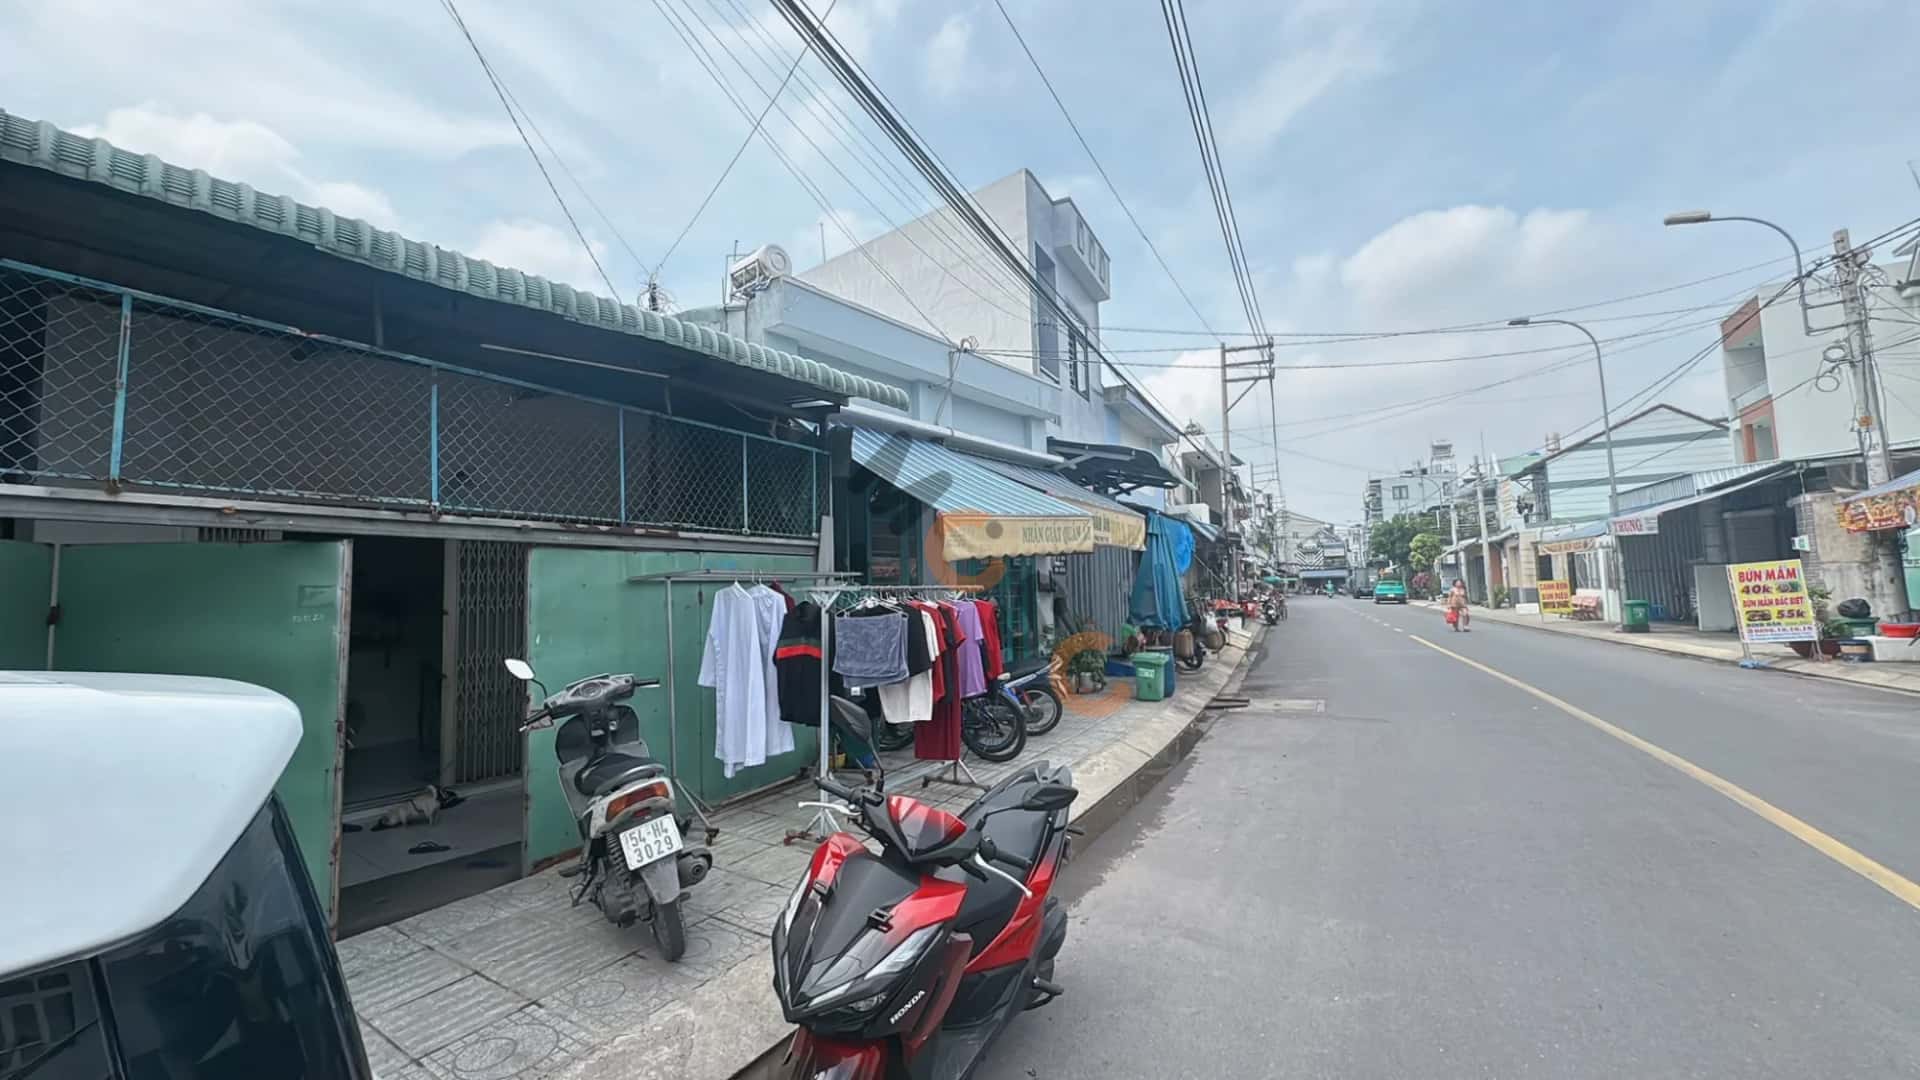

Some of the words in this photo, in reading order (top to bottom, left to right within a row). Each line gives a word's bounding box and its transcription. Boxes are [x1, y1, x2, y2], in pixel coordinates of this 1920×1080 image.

[628, 820, 669, 847] 54-H4
[633, 835, 674, 863] 3029
[890, 990, 925, 1024] HONDA
